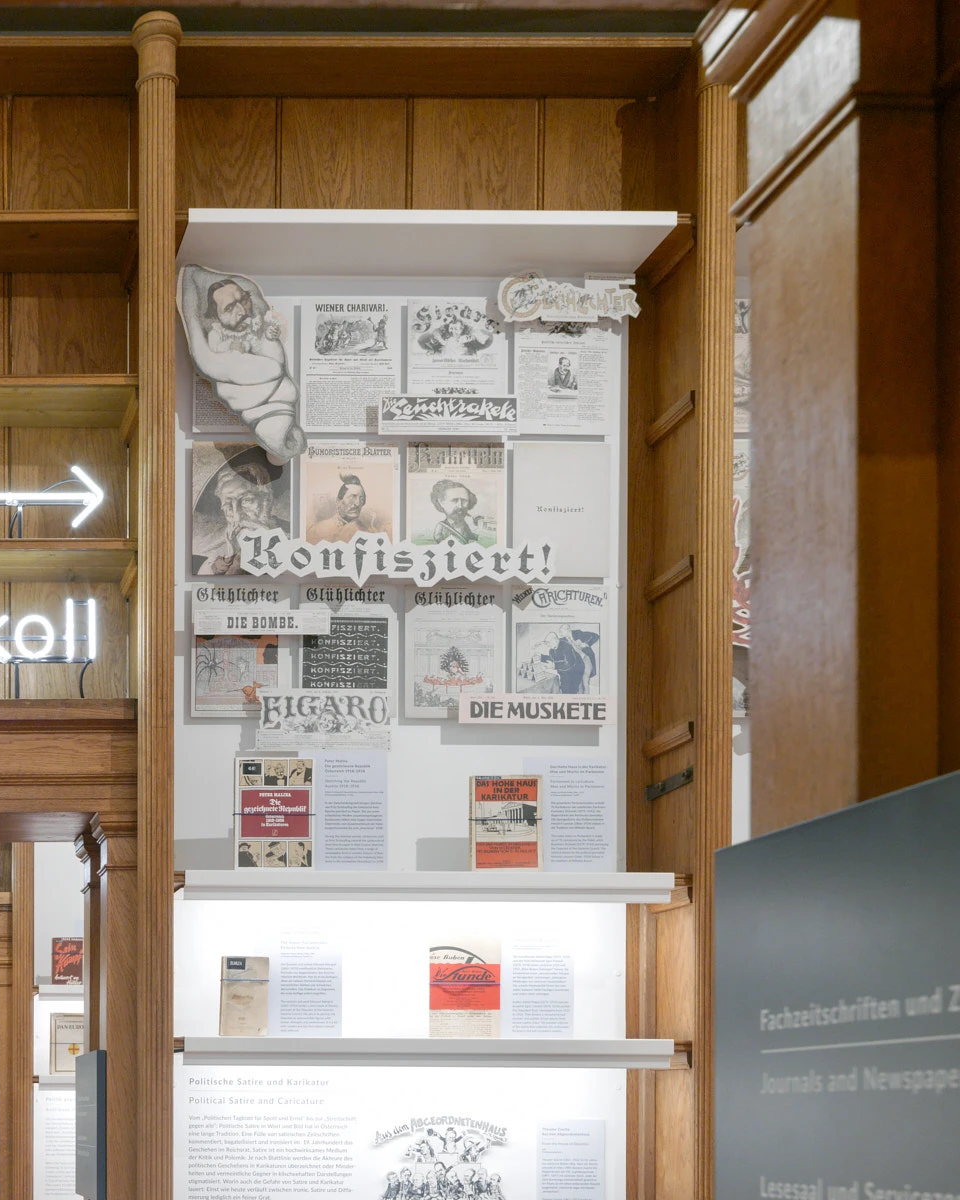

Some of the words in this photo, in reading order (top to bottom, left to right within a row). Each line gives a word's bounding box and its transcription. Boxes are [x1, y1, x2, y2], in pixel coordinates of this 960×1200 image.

[315, 303, 344, 313] WIENER
[346, 303, 389, 313] CHARIVARI.
[536, 505, 584, 513] Konfisziert!
[241, 534, 551, 581] Konfisziert!
[196, 587, 279, 604] Glühlichter
[306, 587, 385, 604] Glühlichter
[414, 591, 495, 608] Glühlichter
[227, 616, 247, 629] DIE
[252, 616, 299, 629] BOMBE.
[331, 624, 380, 632] FISZIERT.
[470, 702, 503, 718] DIE
[507, 702, 607, 720] MUSKETE
[760, 995, 901, 1031] Fachzeitschriften
[906, 989, 942, 1016] und
[189, 1077, 234, 1086] Politische
[237, 1078, 264, 1086] Satire
[267, 1078, 283, 1086] und
[287, 1078, 330, 1086] Karikatur
[760, 1069, 823, 1095] Journals
[827, 1067, 858, 1092] and
[188, 1096, 225, 1104] Political
[228, 1096, 255, 1105] Satire
[257, 1097, 274, 1105] and
[277, 1097, 325, 1105] Caricature
